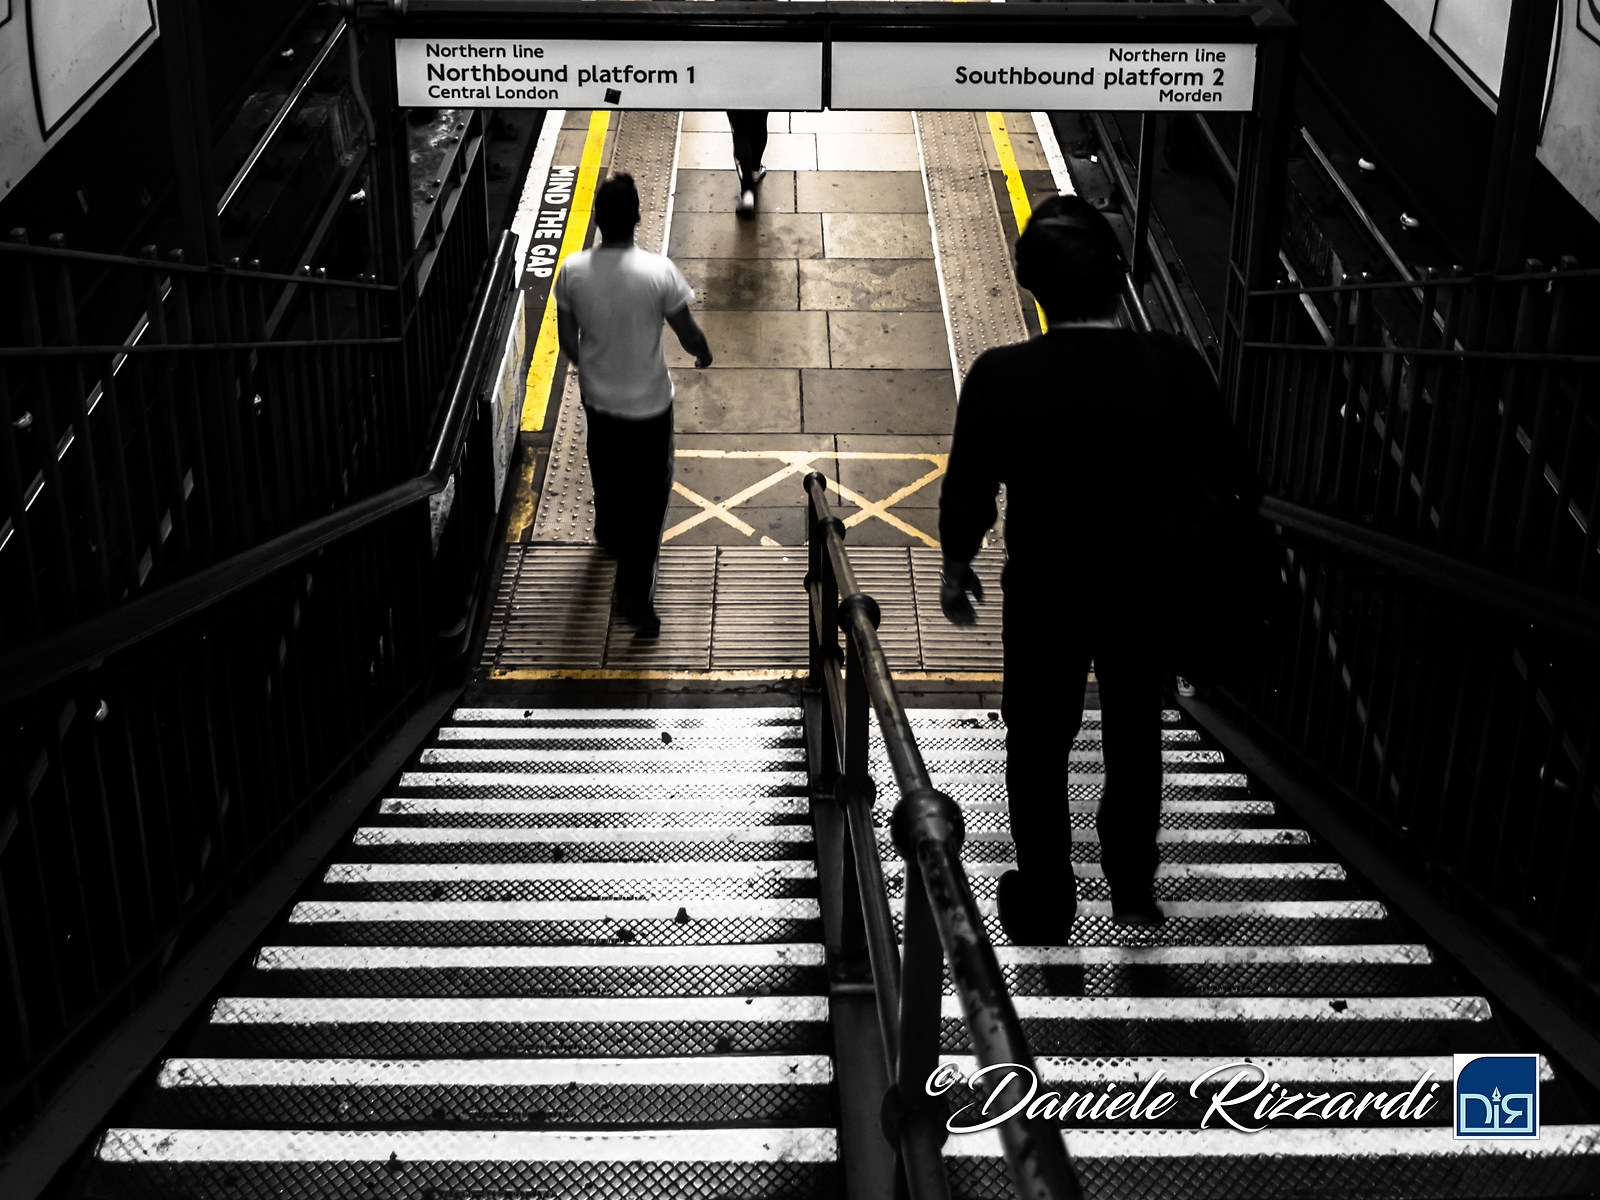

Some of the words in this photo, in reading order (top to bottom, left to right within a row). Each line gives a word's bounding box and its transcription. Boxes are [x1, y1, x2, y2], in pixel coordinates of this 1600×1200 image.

[426, 43, 506, 58] Northern
[513, 44, 544, 58] line
[1109, 48, 1188, 62] Northern
[1195, 48, 1226, 62] line
[427, 63, 568, 82] Northbound
[578, 65, 678, 87] platform
[686, 66, 695, 84] 1
[955, 66, 1095, 85] Southbound
[1104, 67, 1204, 89] platform
[1212, 68, 1225, 86] 2
[428, 85, 491, 99] Central
[496, 86, 558, 100] London
[1159, 89, 1222, 102] Morden
[543, 166, 577, 205] MIND
[534, 208, 567, 239] THE
[525, 244, 558, 278] GAP
